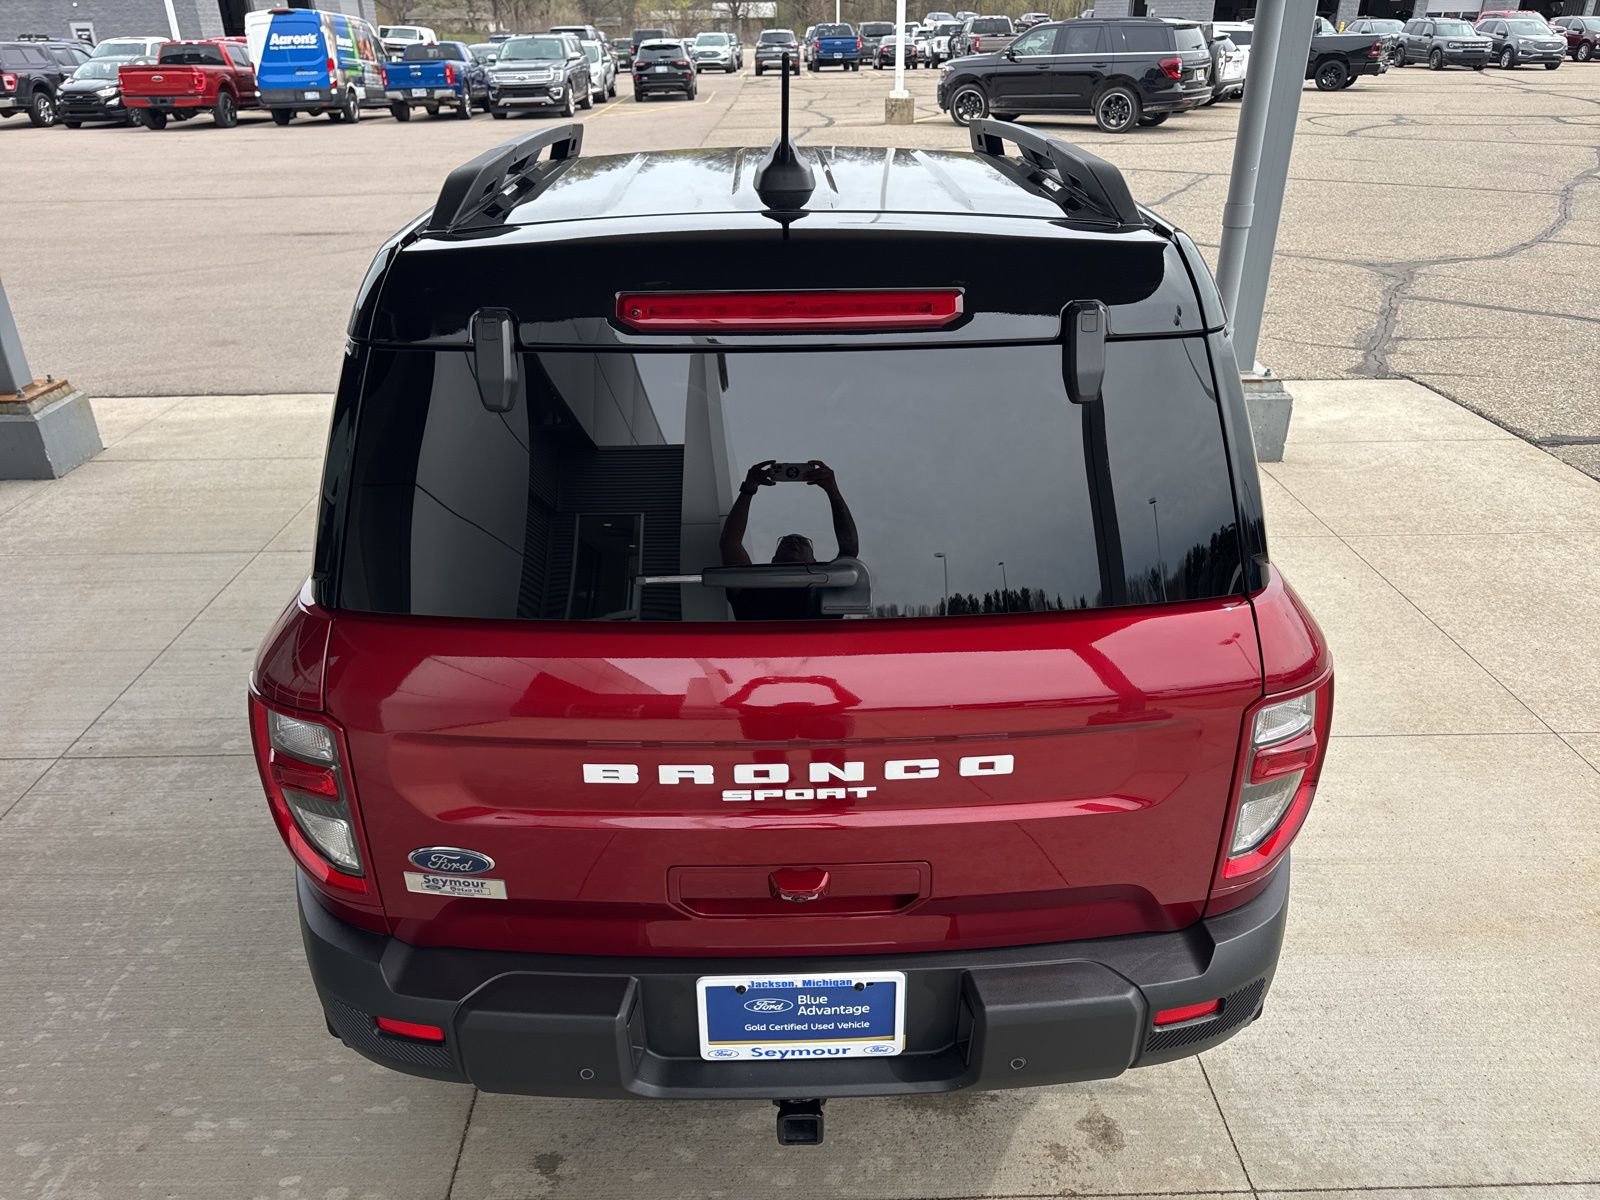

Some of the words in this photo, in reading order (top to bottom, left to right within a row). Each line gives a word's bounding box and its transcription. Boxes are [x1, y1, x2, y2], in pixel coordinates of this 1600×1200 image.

[269, 32, 318, 45] Aaron's
[583, 754, 1014, 785] BRONCO
[722, 786, 877, 801] SPORT
[427, 853, 474, 872] Ford
[423, 875, 486, 888] Seymour
[748, 980, 798, 988] Jackson,
[801, 979, 853, 987] Michigan
[797, 994, 828, 1005] Blue
[797, 1005, 871, 1016] Advantage
[744, 1023, 767, 1031] Gold
[768, 1023, 808, 1031] Certified
[810, 1022, 835, 1030] Used
[836, 1020, 871, 1029] Vehicle
[751, 1047, 851, 1060] Seymour
